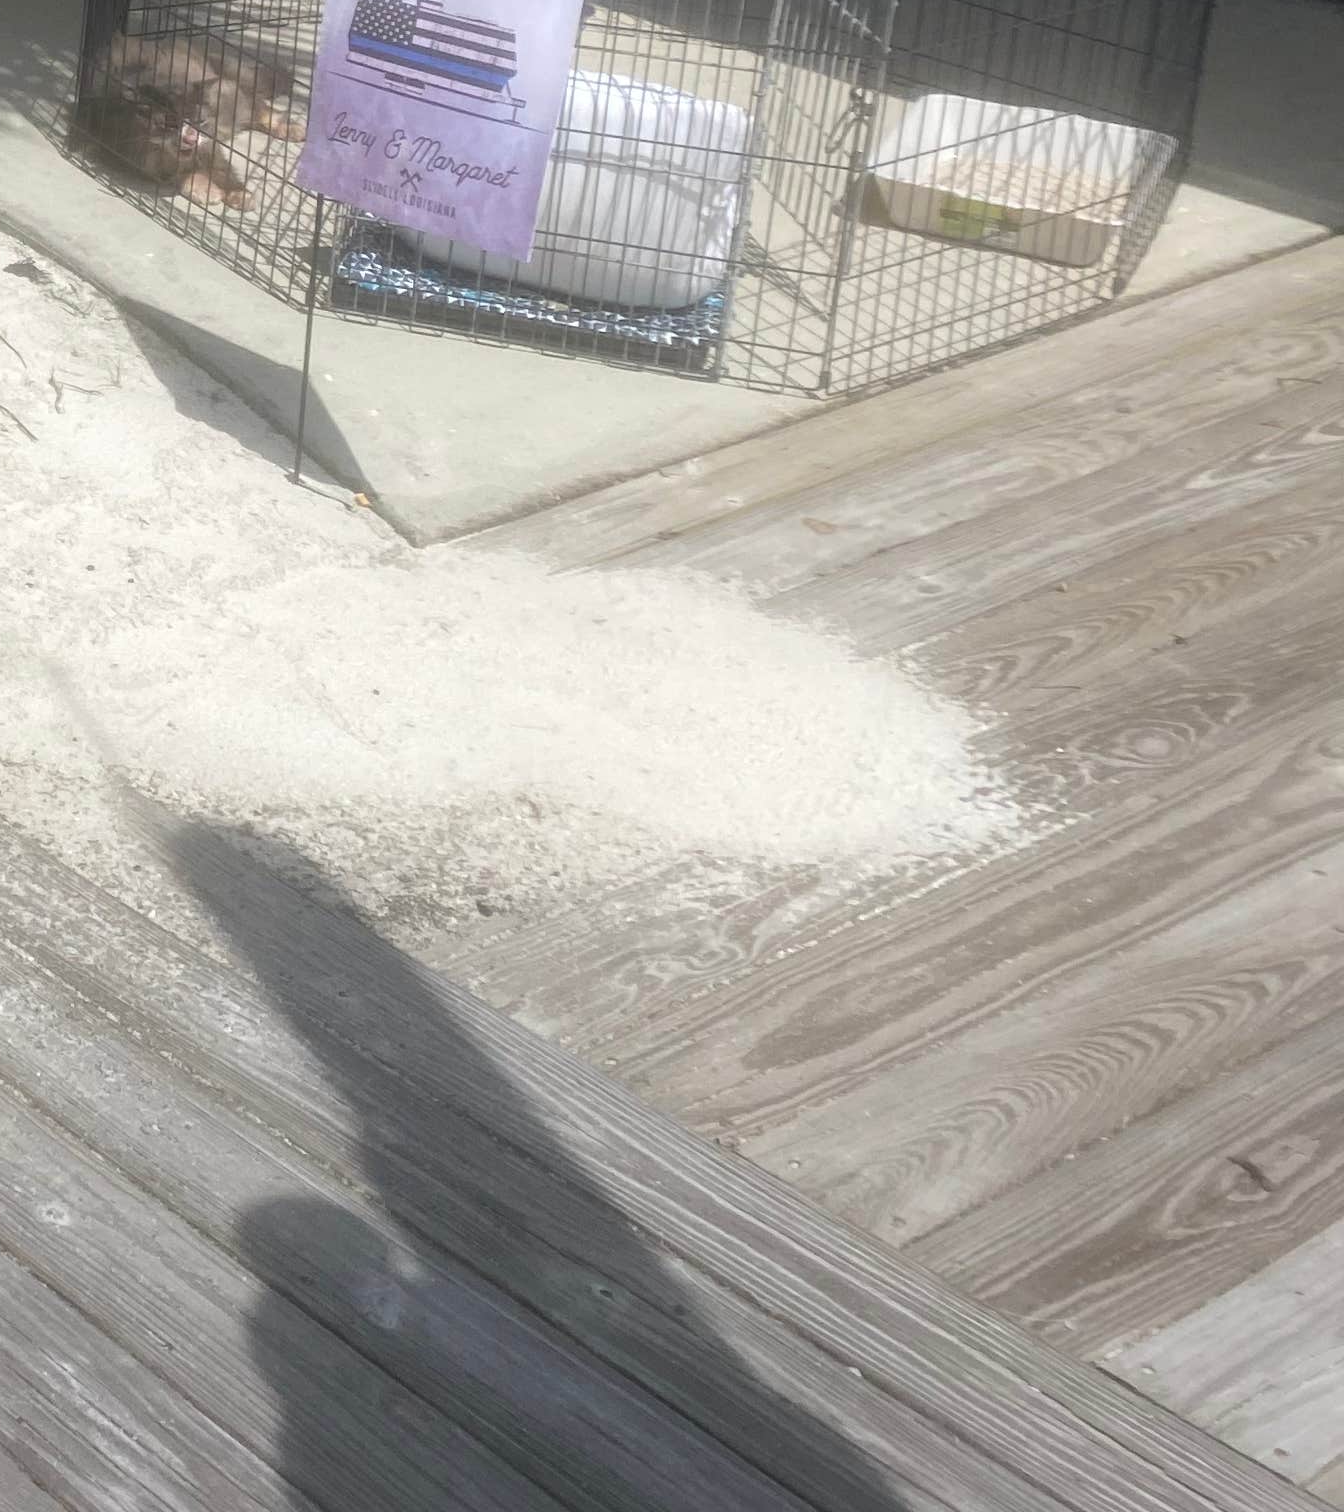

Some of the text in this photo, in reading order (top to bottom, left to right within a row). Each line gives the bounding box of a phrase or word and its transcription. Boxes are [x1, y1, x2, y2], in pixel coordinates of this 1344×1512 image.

[384, 128, 407, 160] &
[409, 136, 520, 189] Margaret
[402, 192, 457, 220] LOUISIANA
